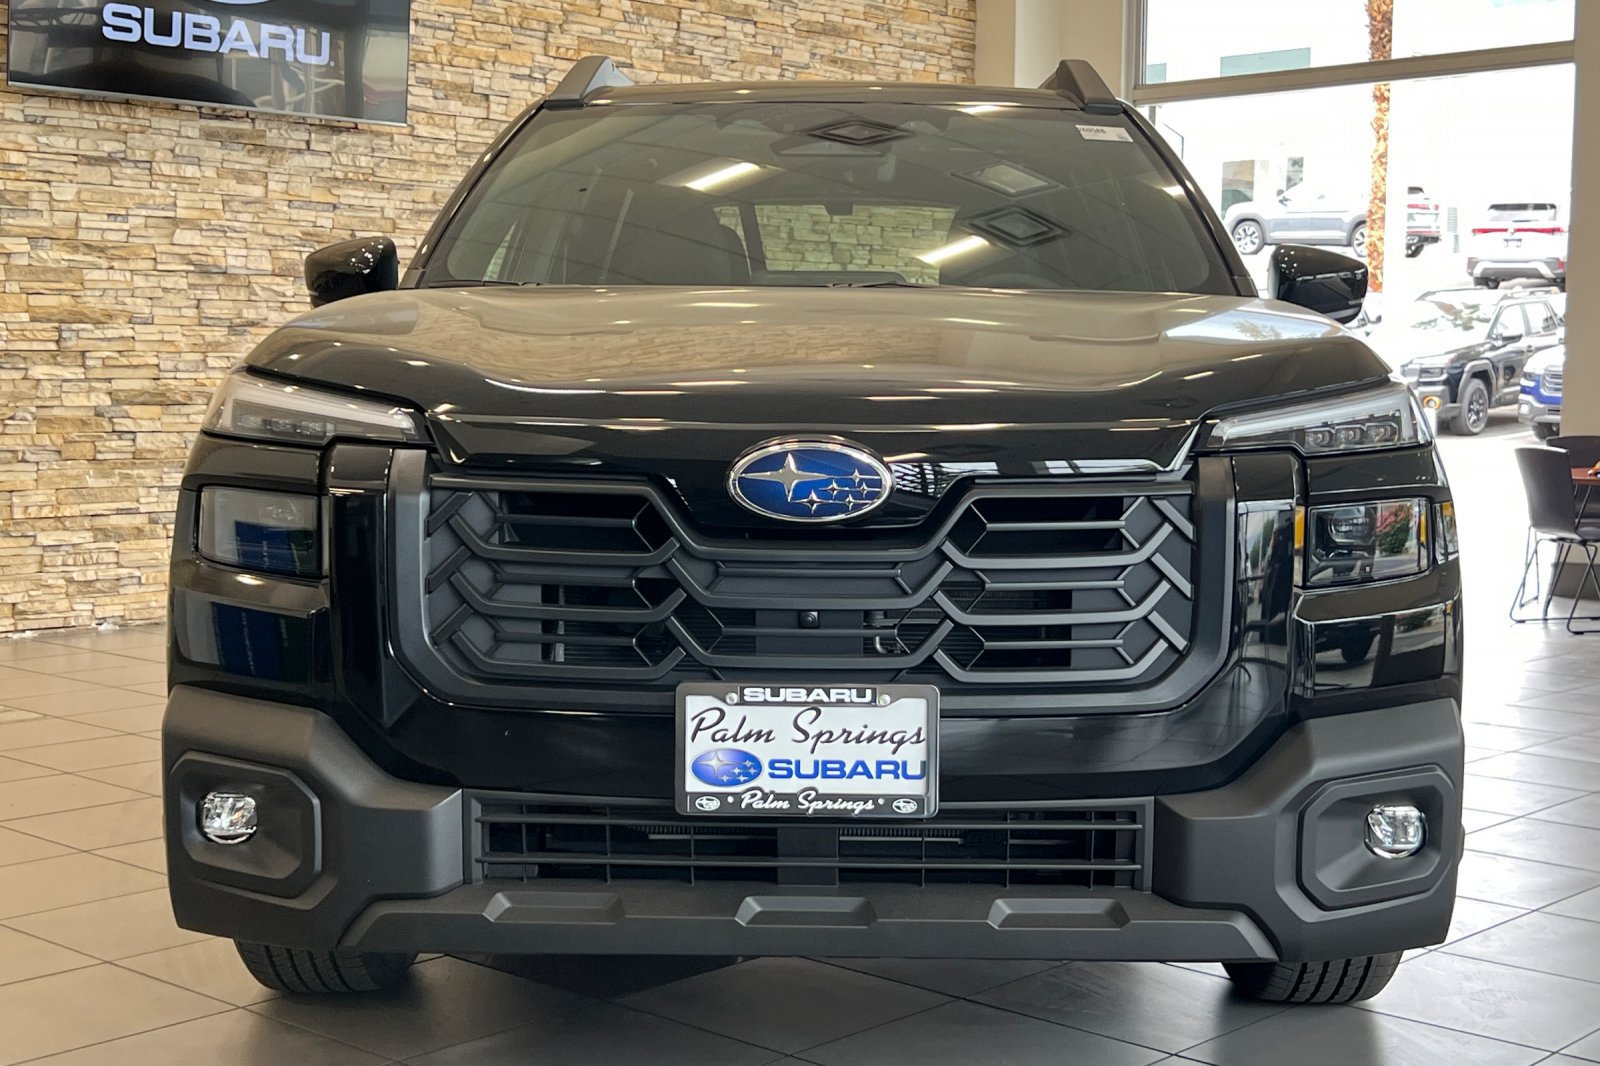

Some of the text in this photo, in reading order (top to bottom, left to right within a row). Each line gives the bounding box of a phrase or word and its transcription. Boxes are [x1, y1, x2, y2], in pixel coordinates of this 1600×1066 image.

[102, 3, 331, 66] SUBARU
[743, 687, 873, 703] SUBARU
[690, 706, 926, 755] Palm Springs
[768, 759, 926, 780] SUBARU
[740, 789, 875, 815] Palm Springs
